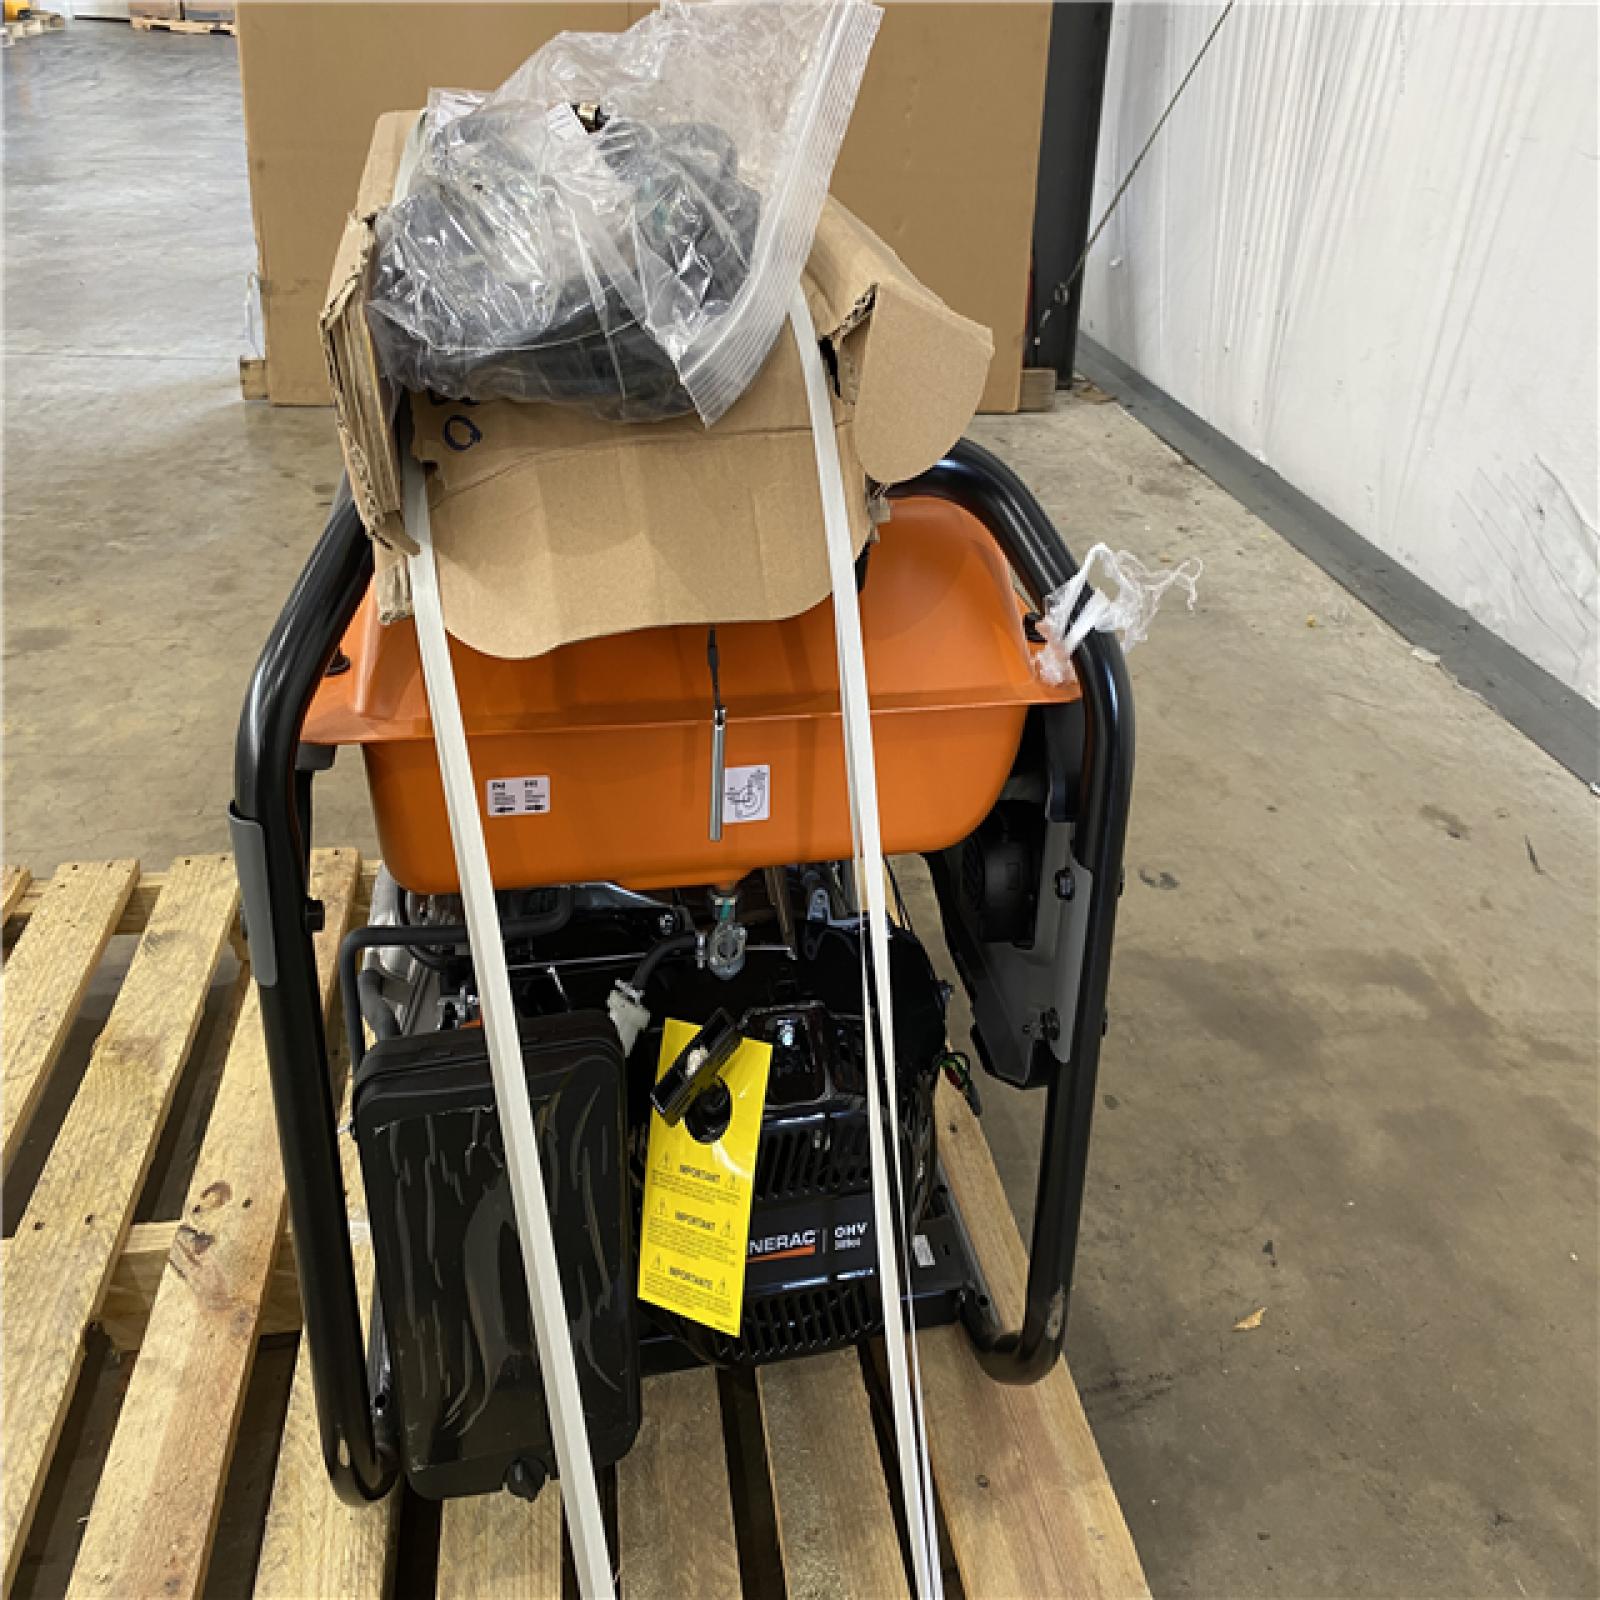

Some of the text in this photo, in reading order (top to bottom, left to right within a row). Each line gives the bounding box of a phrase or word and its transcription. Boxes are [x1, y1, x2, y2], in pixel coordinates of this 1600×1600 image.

[679, 1164, 721, 1182] IMPORTANT
[674, 1211, 716, 1231] IMPORTANT
[749, 1229, 816, 1255] NERAC
[834, 1221, 868, 1239] OHV
